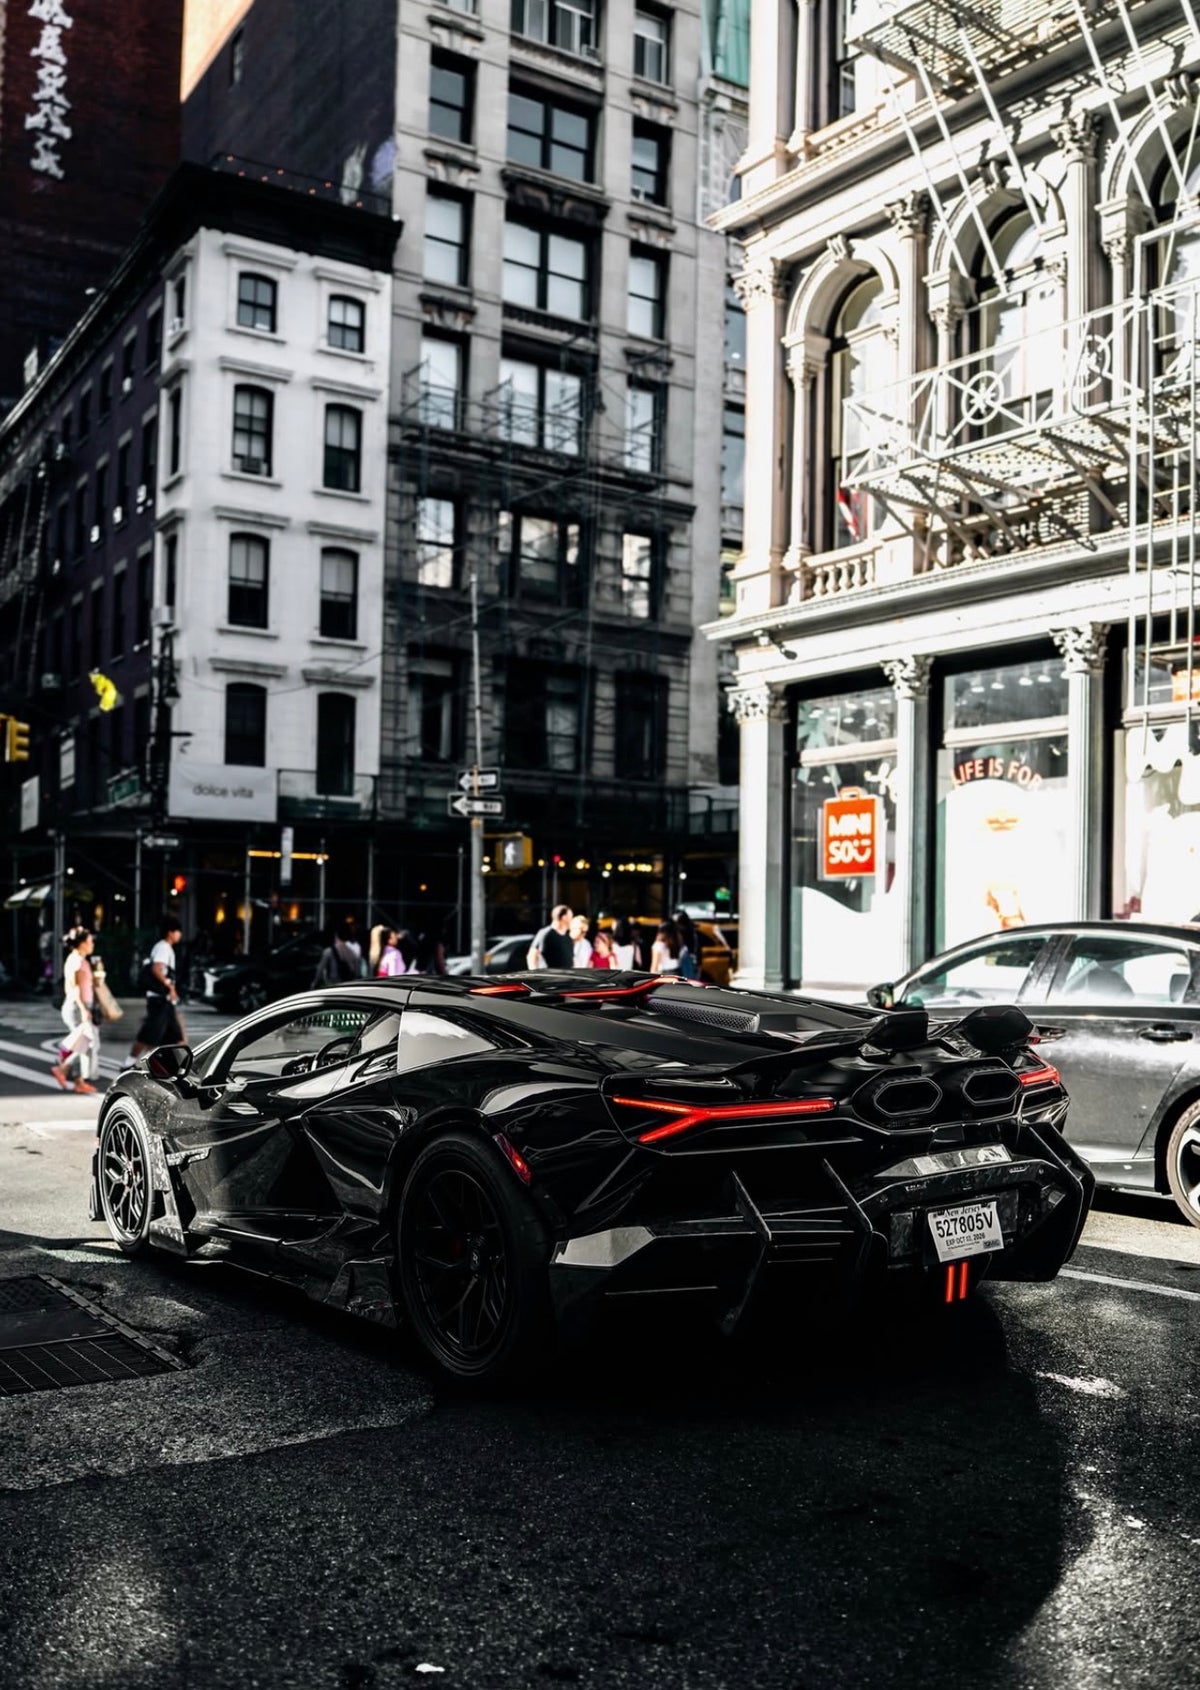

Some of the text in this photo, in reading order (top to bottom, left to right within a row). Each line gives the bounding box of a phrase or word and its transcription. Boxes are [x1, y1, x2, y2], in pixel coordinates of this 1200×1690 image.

[950, 758, 985, 787] LIFE
[988, 757, 1004, 778] IS
[828, 812, 872, 837] MINI
[935, 1211, 993, 1238] 527805V
